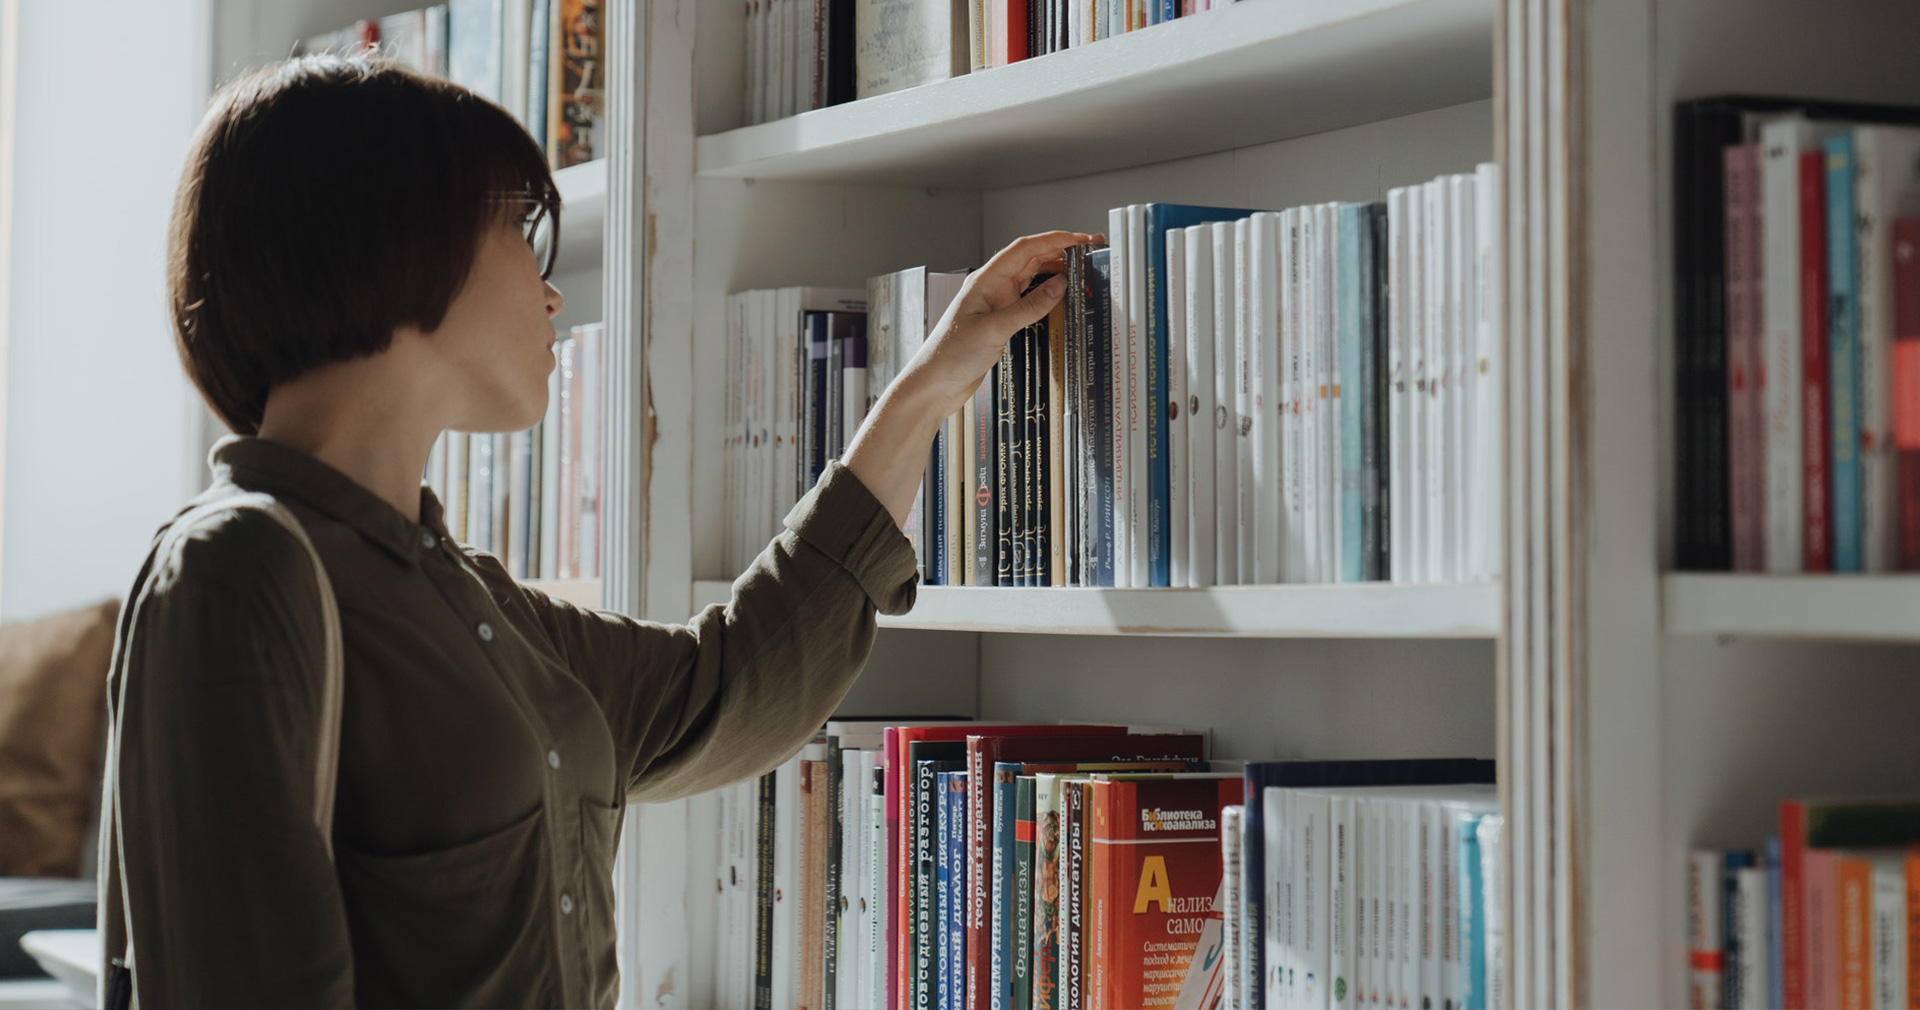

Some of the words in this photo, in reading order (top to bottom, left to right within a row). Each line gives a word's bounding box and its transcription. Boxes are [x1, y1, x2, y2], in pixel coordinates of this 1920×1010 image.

[1102, 287, 1110, 364] ПСИХОАНАЛИЗА
[1112, 256, 1120, 357] ПСИХОЛОГИЯ
[1148, 267, 1156, 391] ПСИХОТЕРАПИИ
[1087, 351, 1095, 386] Театры
[1113, 361, 1123, 500] ИНДИВИДУАЛЬНАЯ
[1149, 395, 1157, 459] ИСТОКИ
[976, 467, 990, 506] Фрейд
[979, 509, 987, 550] Зигмунд
[919, 766, 933, 862] разговор
[939, 782, 948, 868] ДИСКУРС
[974, 752, 986, 843] практики
[1141, 808, 1203, 822] Библиотека
[1143, 819, 1216, 832] психоанализа
[953, 848, 963, 926] ДИАЛОГ
[975, 846, 983, 859] и
[1069, 822, 1081, 927] диктатуры
[974, 862, 986, 929] теории
[1015, 859, 1028, 978] Фанатизм
[1166, 918, 1205, 935] само
[1143, 952, 1170, 966] подход
[1169, 956, 1176, 965] к
